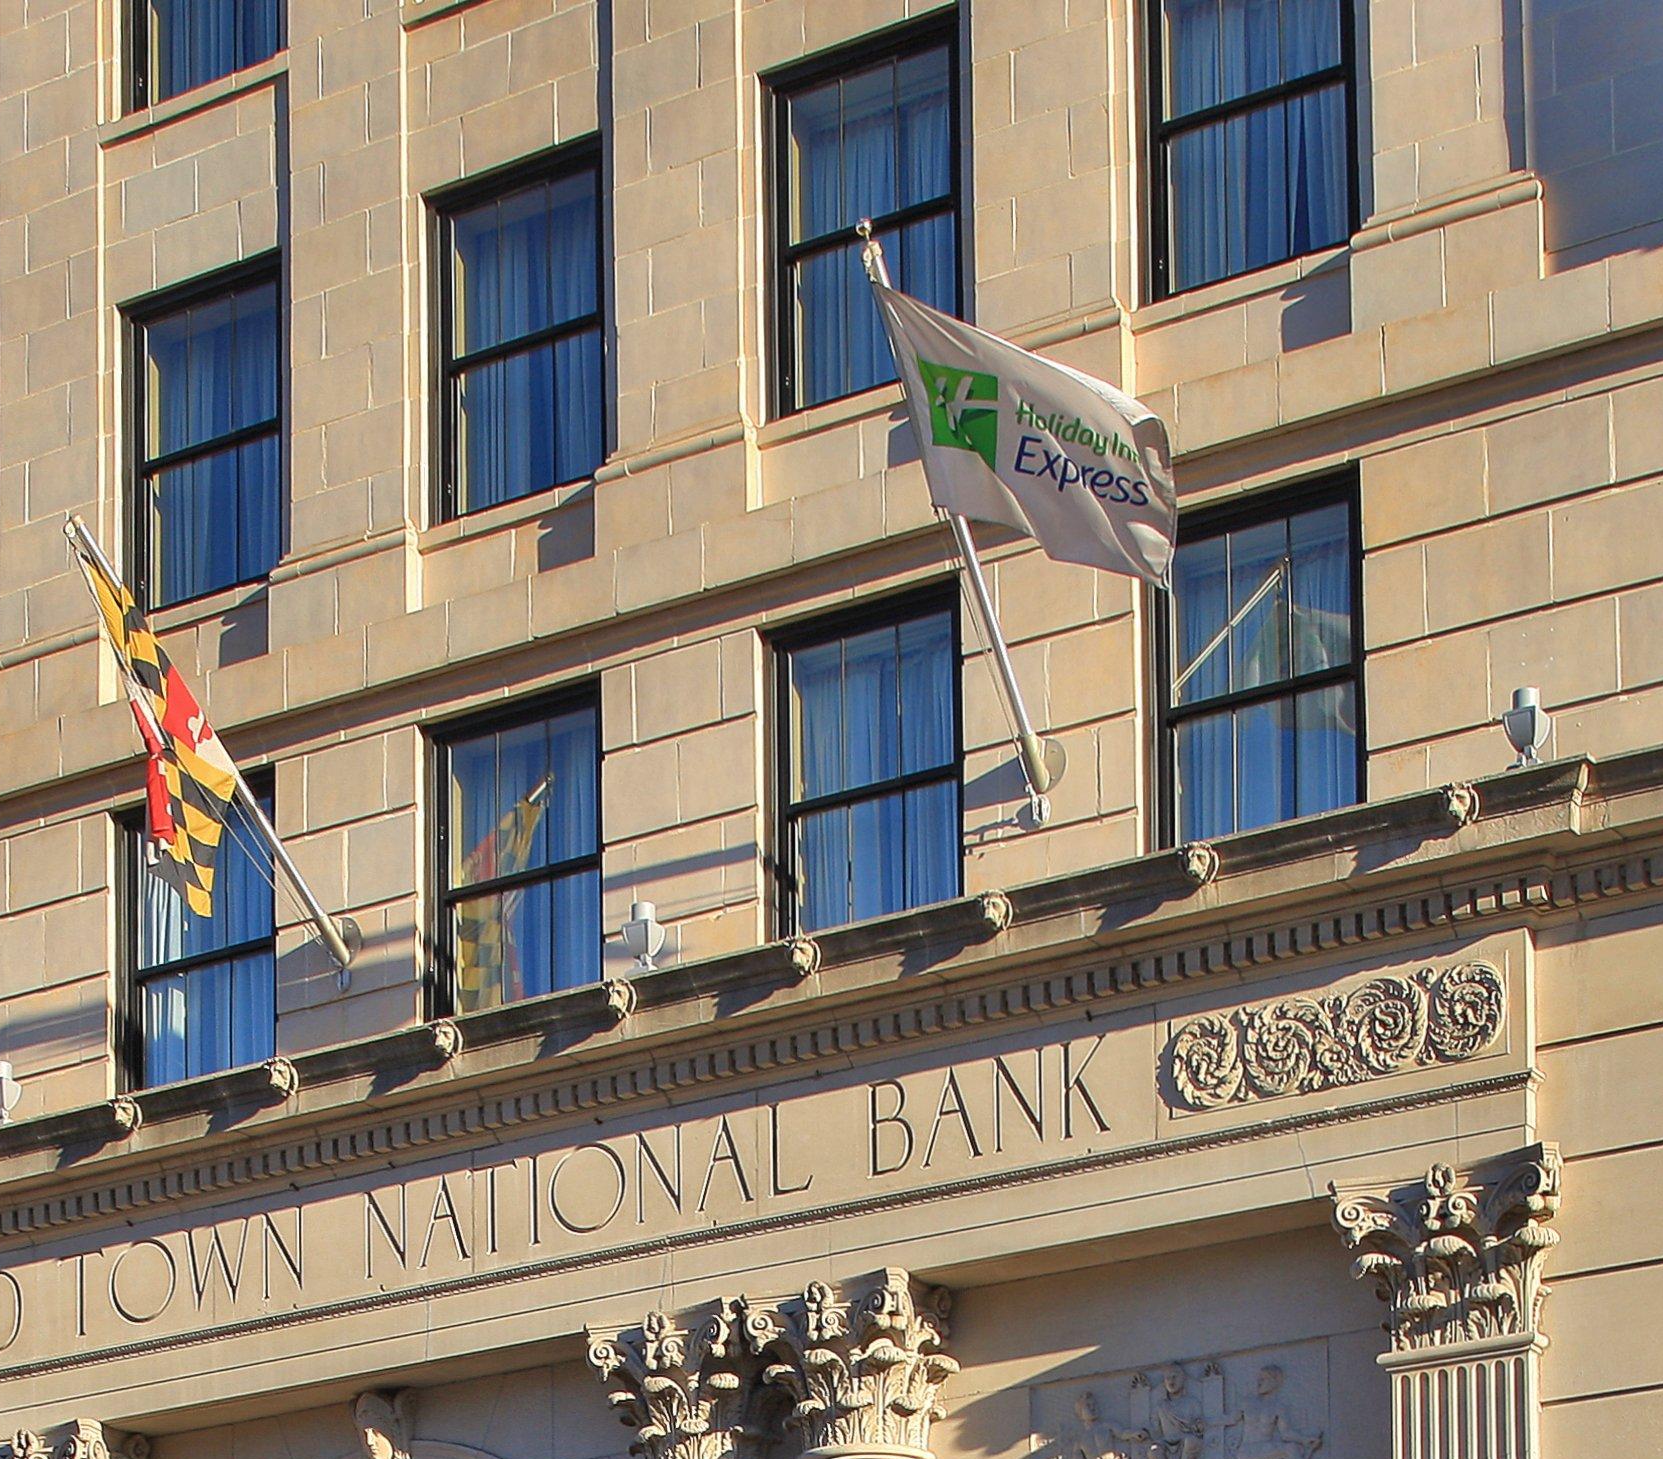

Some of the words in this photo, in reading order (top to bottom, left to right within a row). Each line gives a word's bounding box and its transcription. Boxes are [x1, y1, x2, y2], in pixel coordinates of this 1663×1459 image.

[1016, 398, 1109, 456] Holiday
[1014, 435, 1150, 507] Express
[58, 1205, 305, 1337] TOWN
[362, 1102, 814, 1279] NATIONAL
[866, 1034, 1112, 1180] BANK
